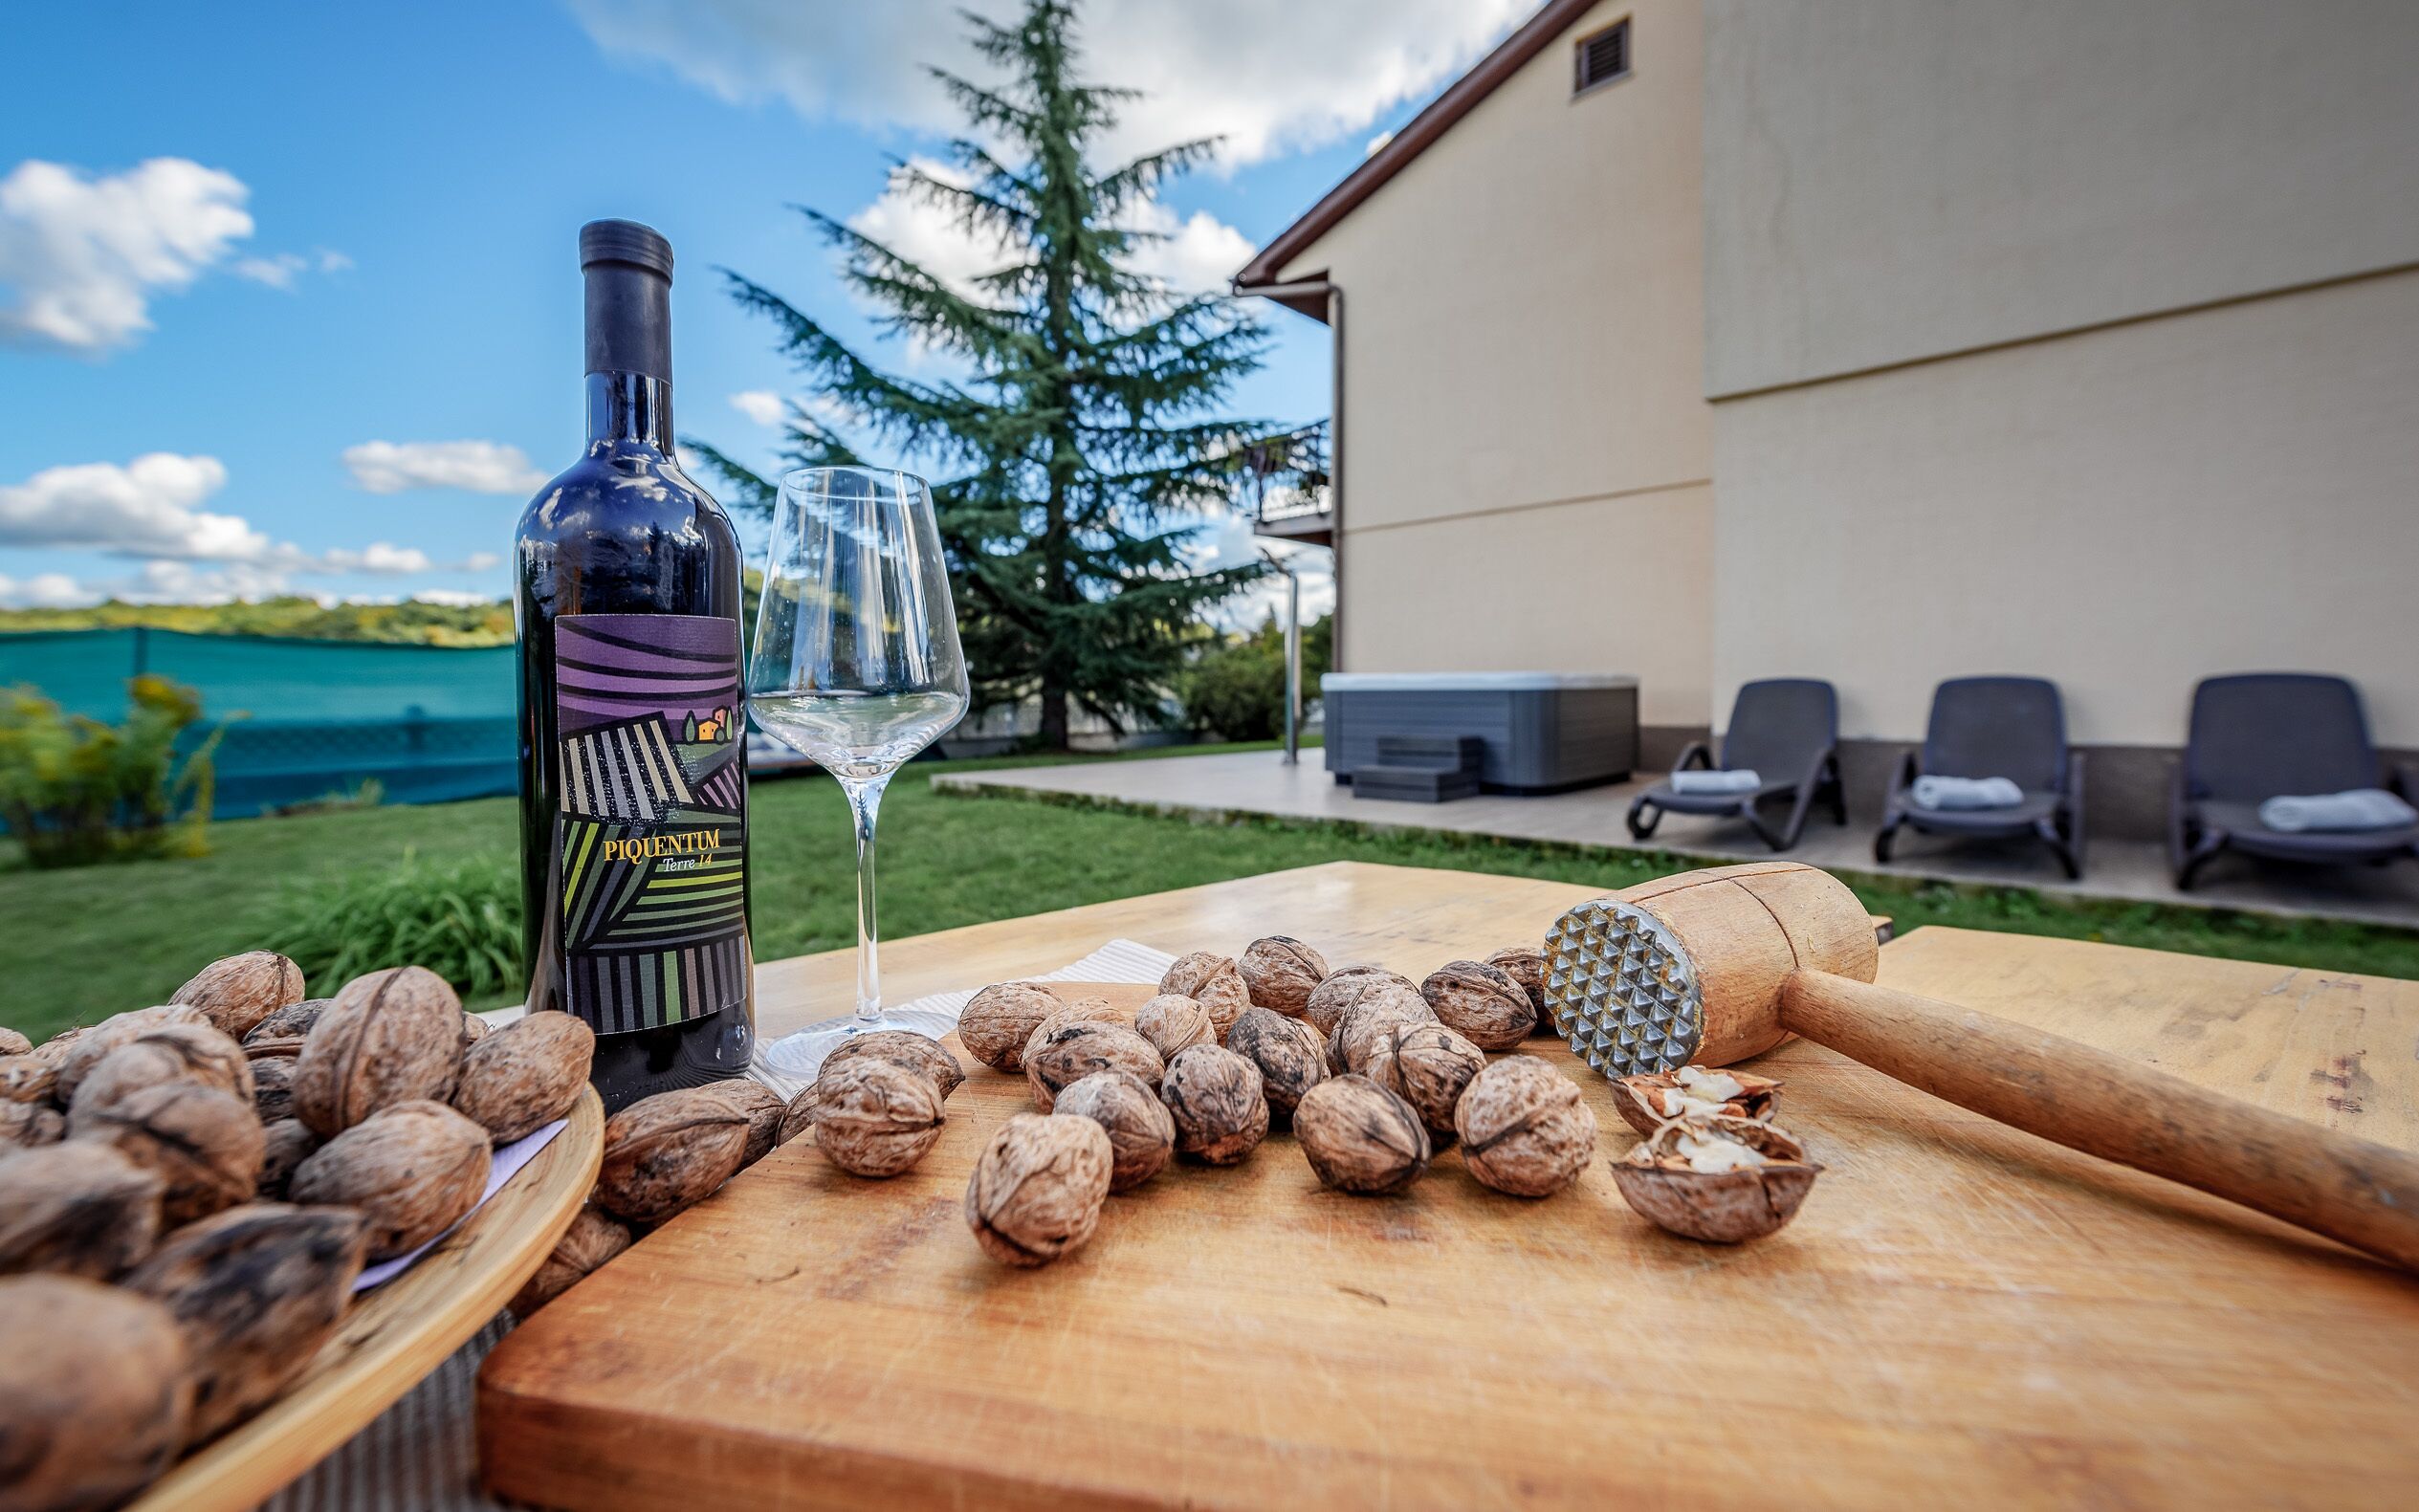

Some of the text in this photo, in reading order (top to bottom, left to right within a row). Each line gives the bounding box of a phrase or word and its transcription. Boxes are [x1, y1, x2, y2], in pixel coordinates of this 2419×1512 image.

[604, 829, 719, 865] PIQUENTUM
[663, 853, 713, 872] Terre 14
